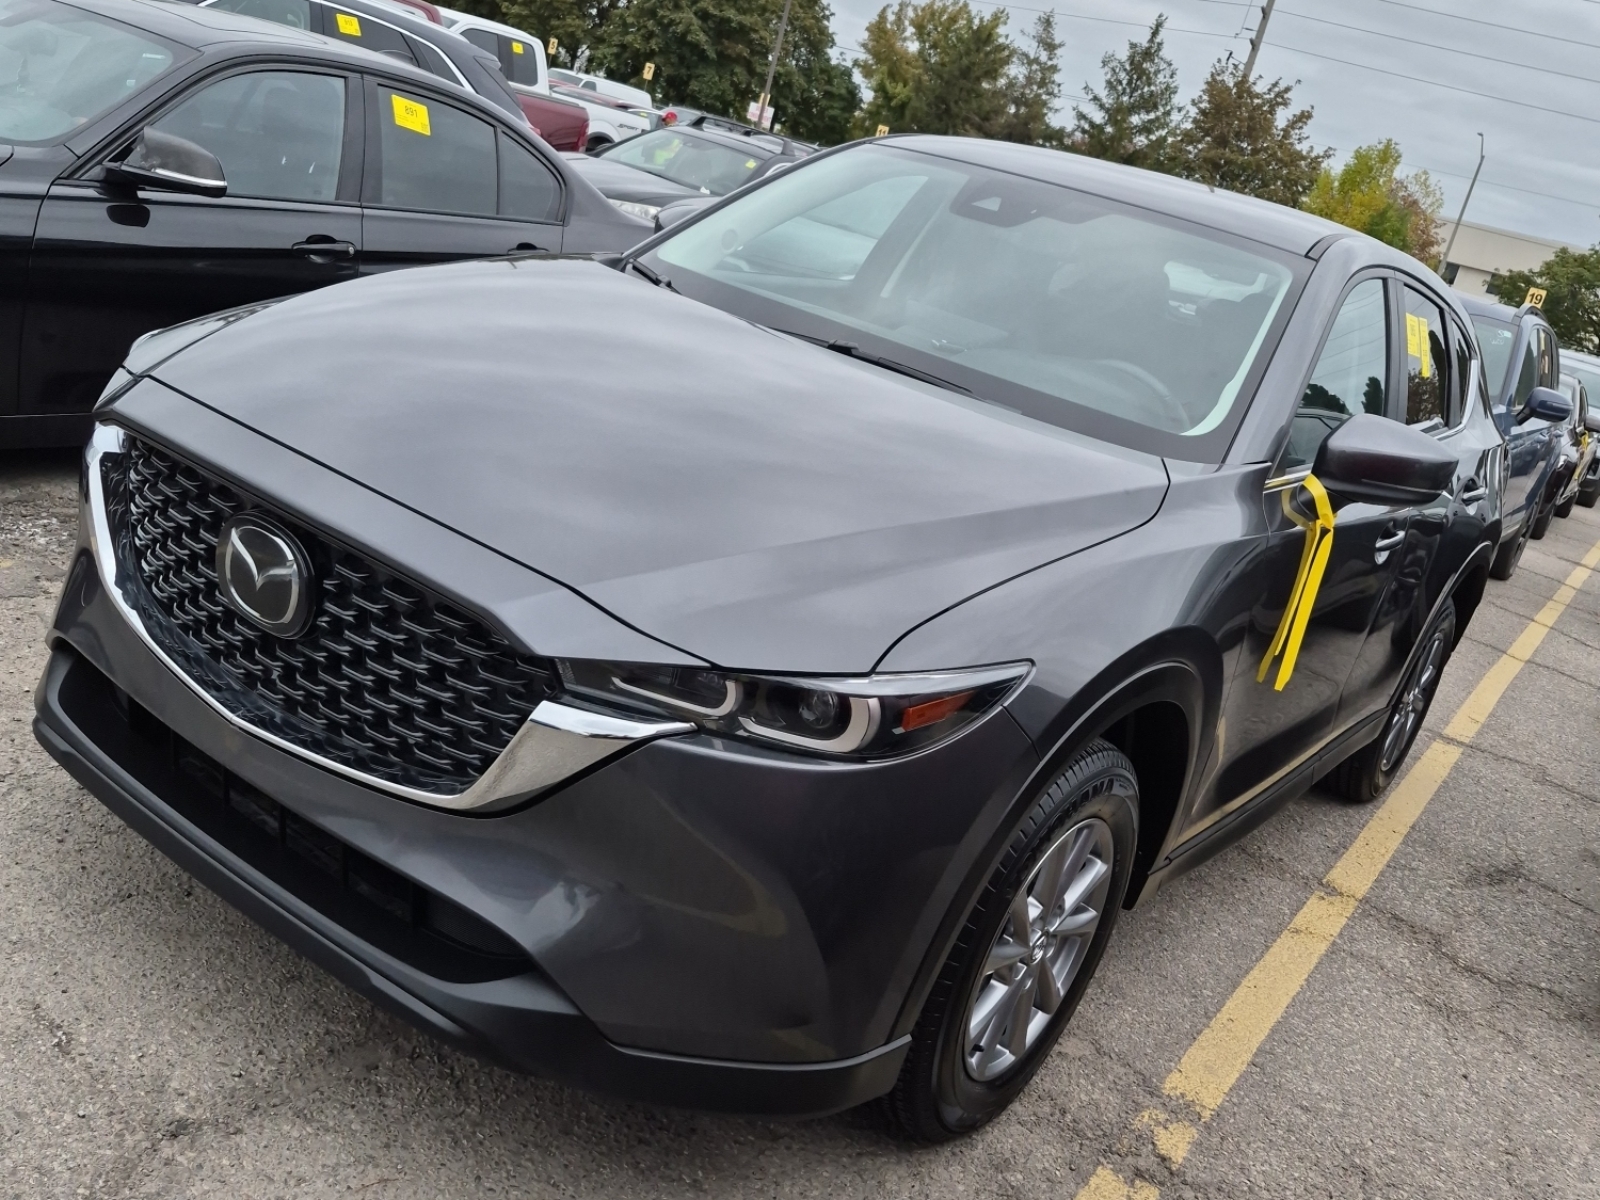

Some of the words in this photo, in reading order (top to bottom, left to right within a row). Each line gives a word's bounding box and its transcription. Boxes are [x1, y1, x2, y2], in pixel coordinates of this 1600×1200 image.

[646, 66, 652, 75] 7
[404, 105, 418, 118] 891
[1529, 291, 1543, 305] 19
